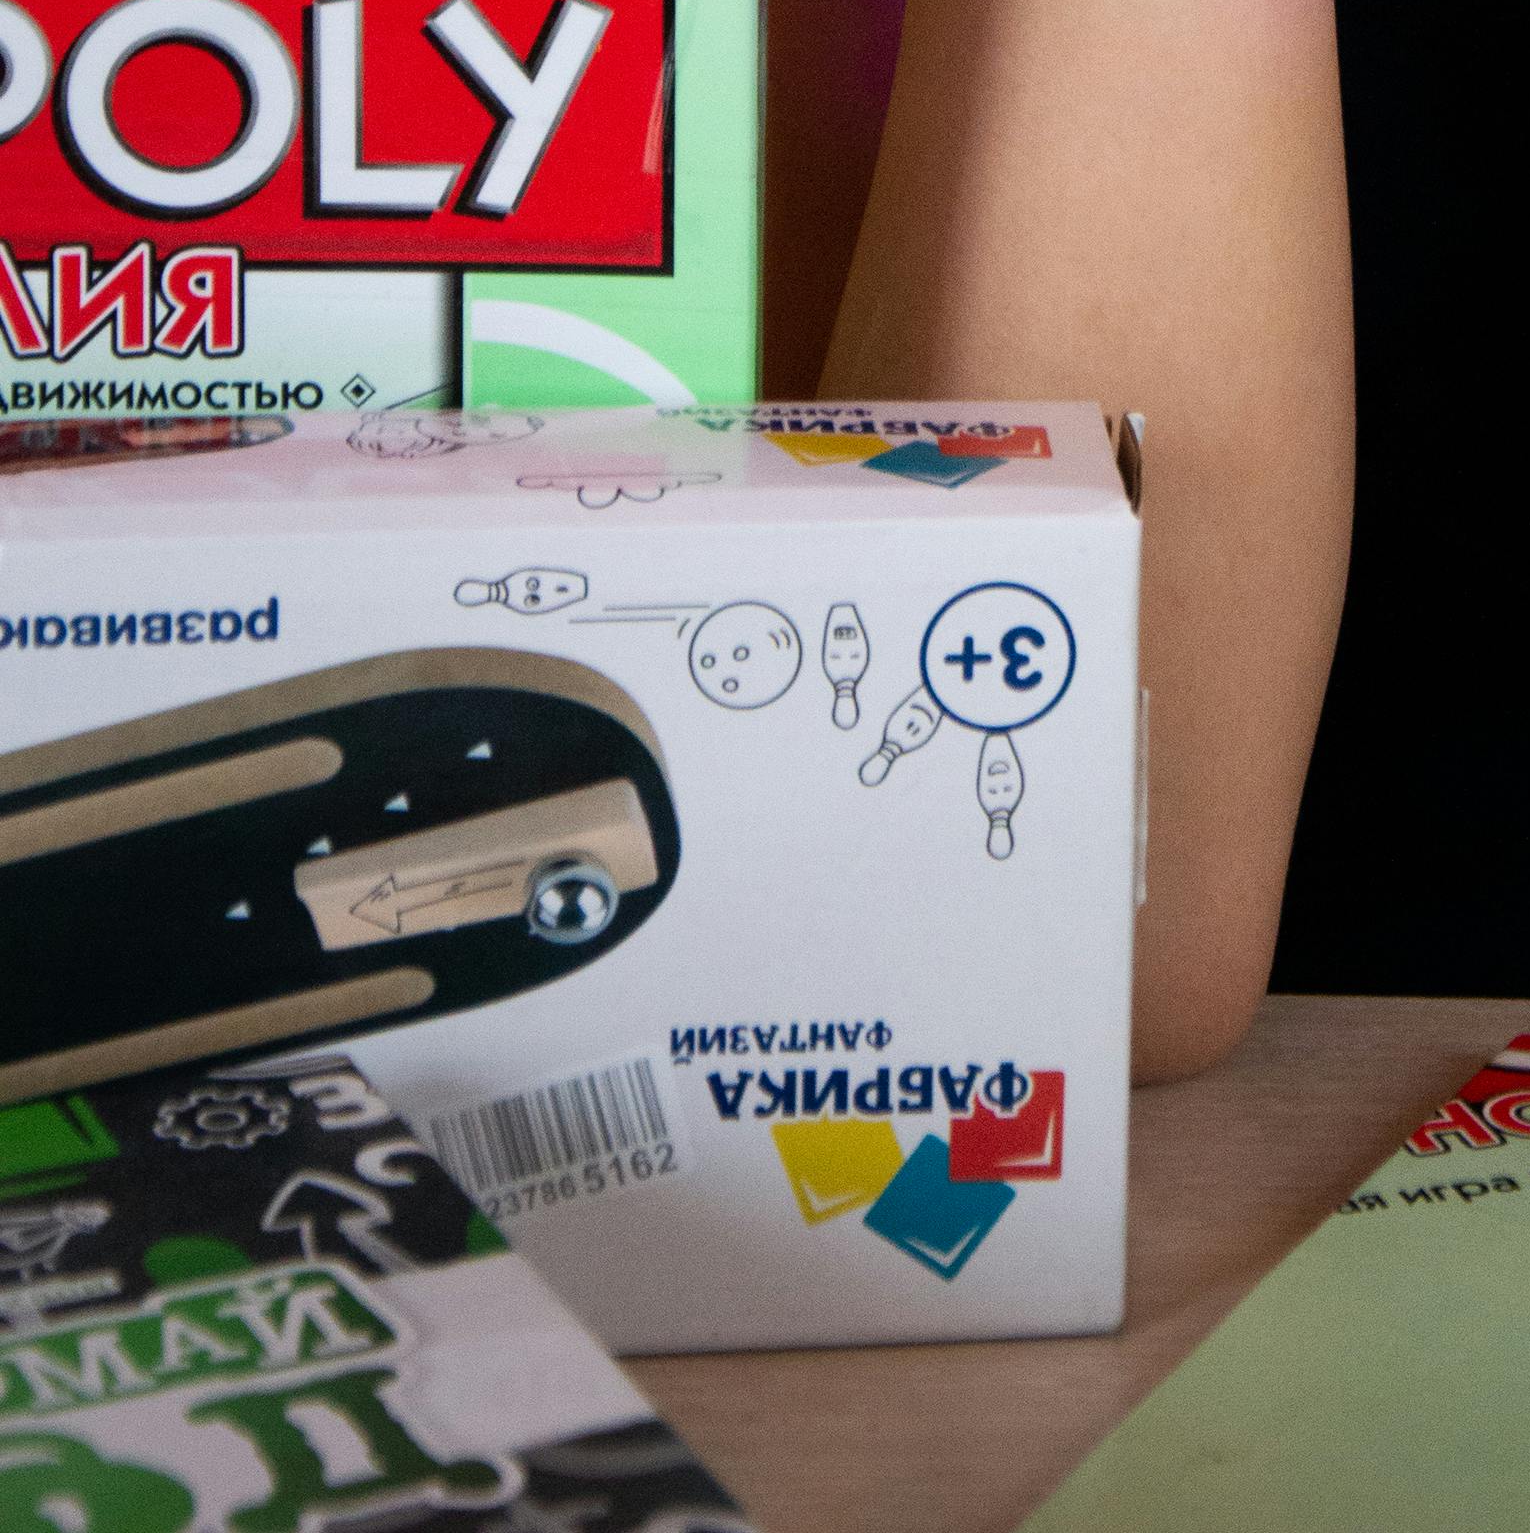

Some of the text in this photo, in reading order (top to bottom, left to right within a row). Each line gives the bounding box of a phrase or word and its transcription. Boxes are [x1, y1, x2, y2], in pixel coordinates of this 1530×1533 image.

[0, 380, 324, 415] ВИЖИМОСТЬЮ
[943, 625, 1046, 691] 3+
[669, 1020, 893, 1065] ФАНТАЗИЙ
[706, 1061, 1030, 1122] ФАБРИКА
[1399, 1173, 1520, 1204] игра
[0, 1277, 372, 1415] МАЙ
